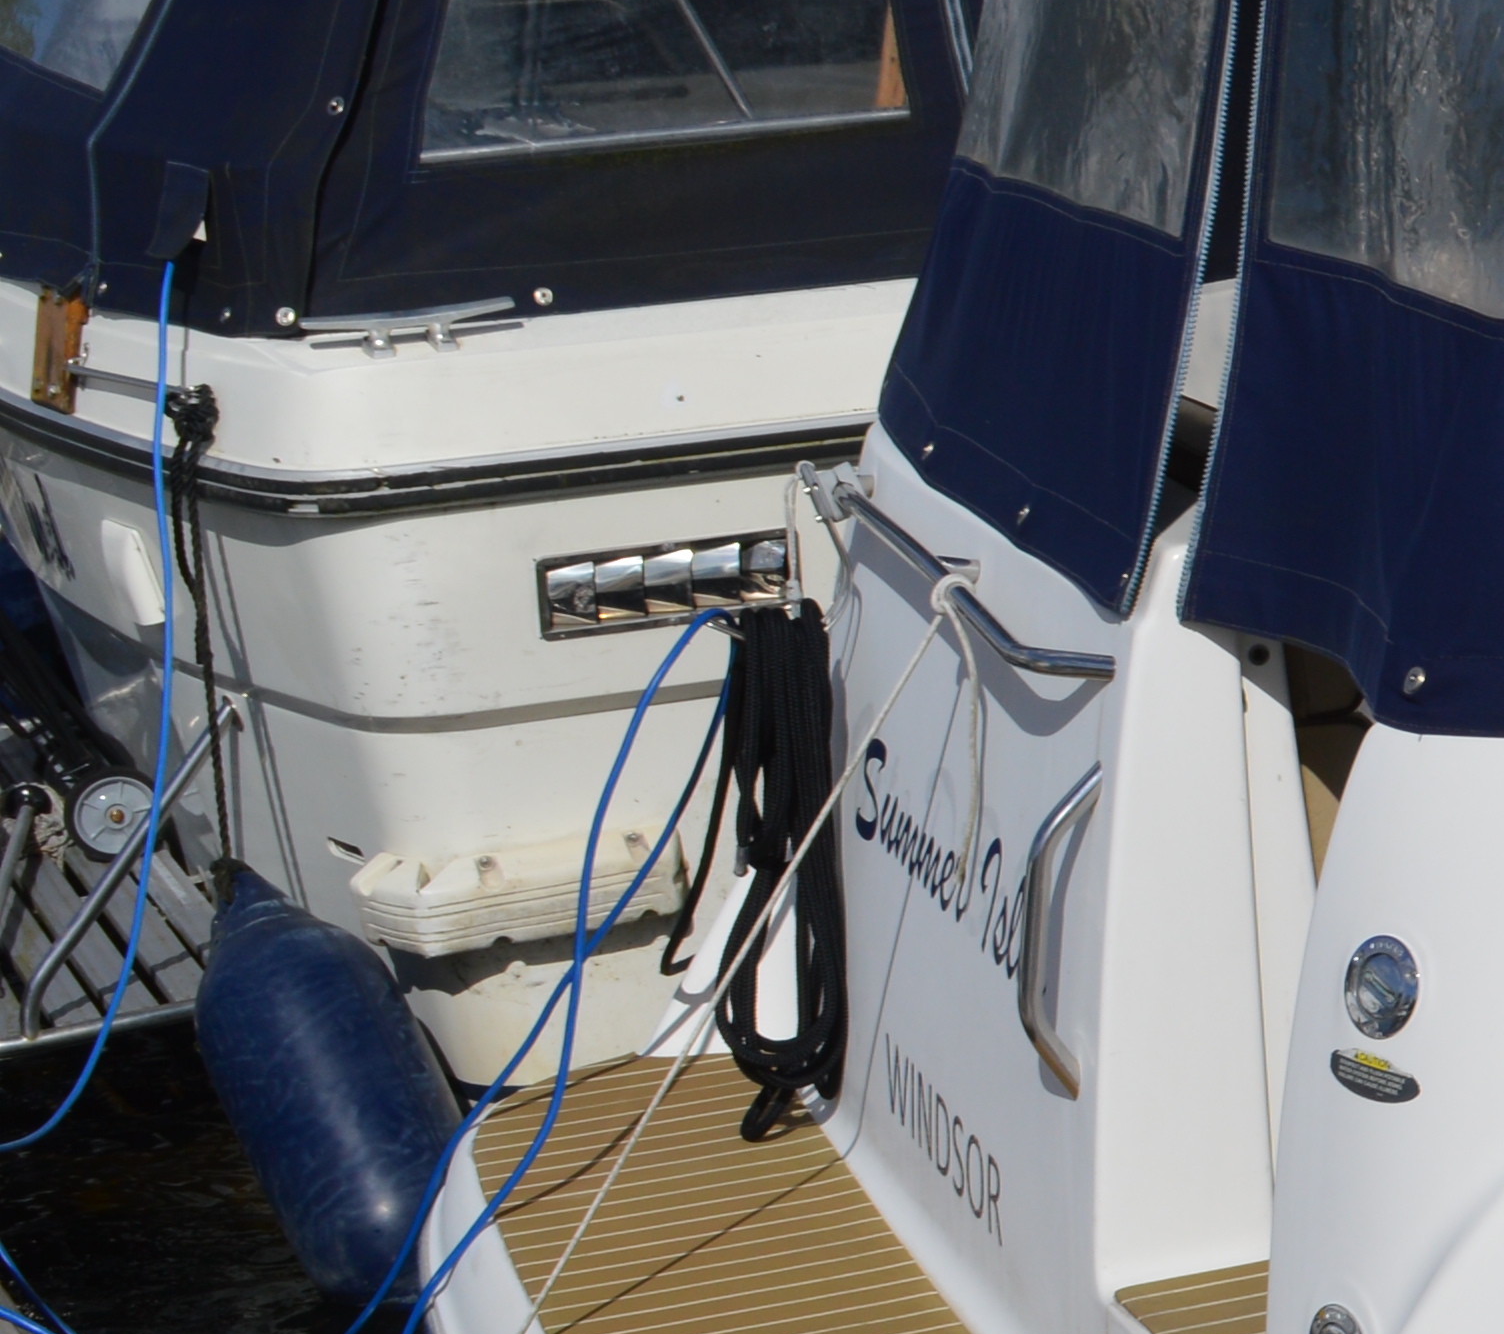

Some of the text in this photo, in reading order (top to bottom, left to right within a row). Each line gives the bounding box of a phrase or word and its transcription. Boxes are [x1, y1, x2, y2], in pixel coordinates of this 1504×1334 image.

[856, 738, 1047, 997] Summer Isl
[885, 1033, 1003, 1246] WINDSOR
